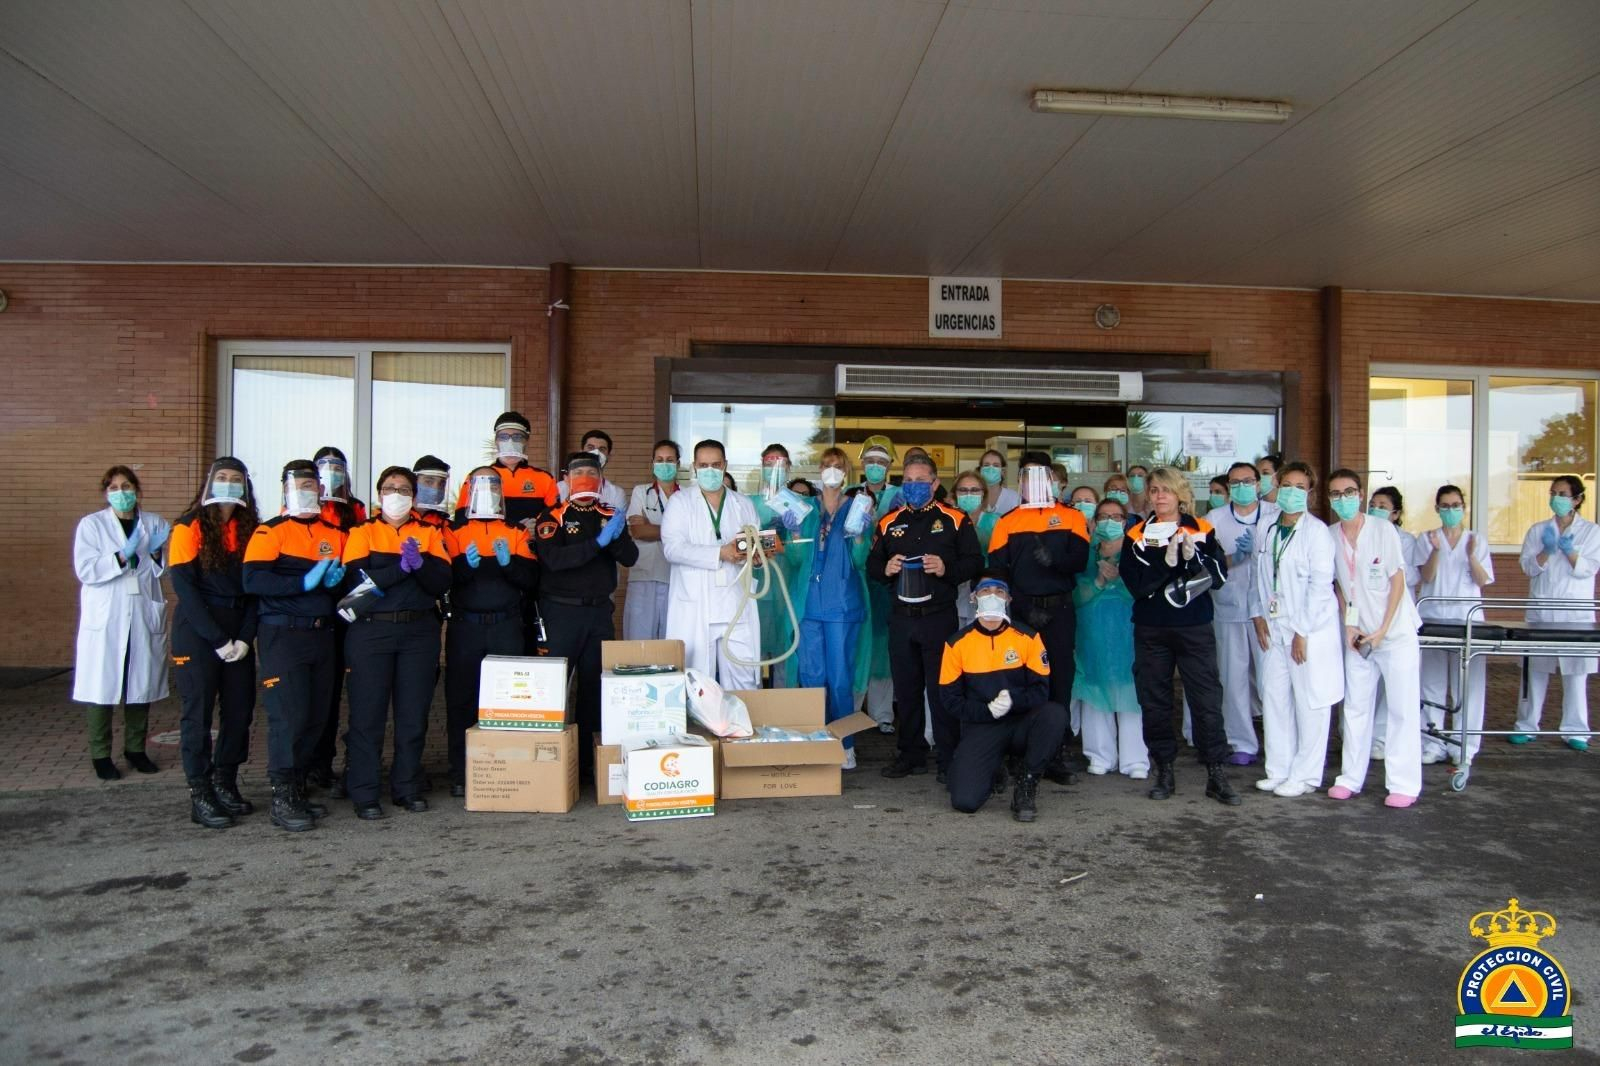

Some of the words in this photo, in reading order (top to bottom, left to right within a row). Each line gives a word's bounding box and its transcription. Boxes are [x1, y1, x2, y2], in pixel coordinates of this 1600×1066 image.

[941, 284, 990, 301] ENTRADA
[935, 314, 995, 330] URGENCIAS
[644, 779, 700, 791] CODIAGRO
